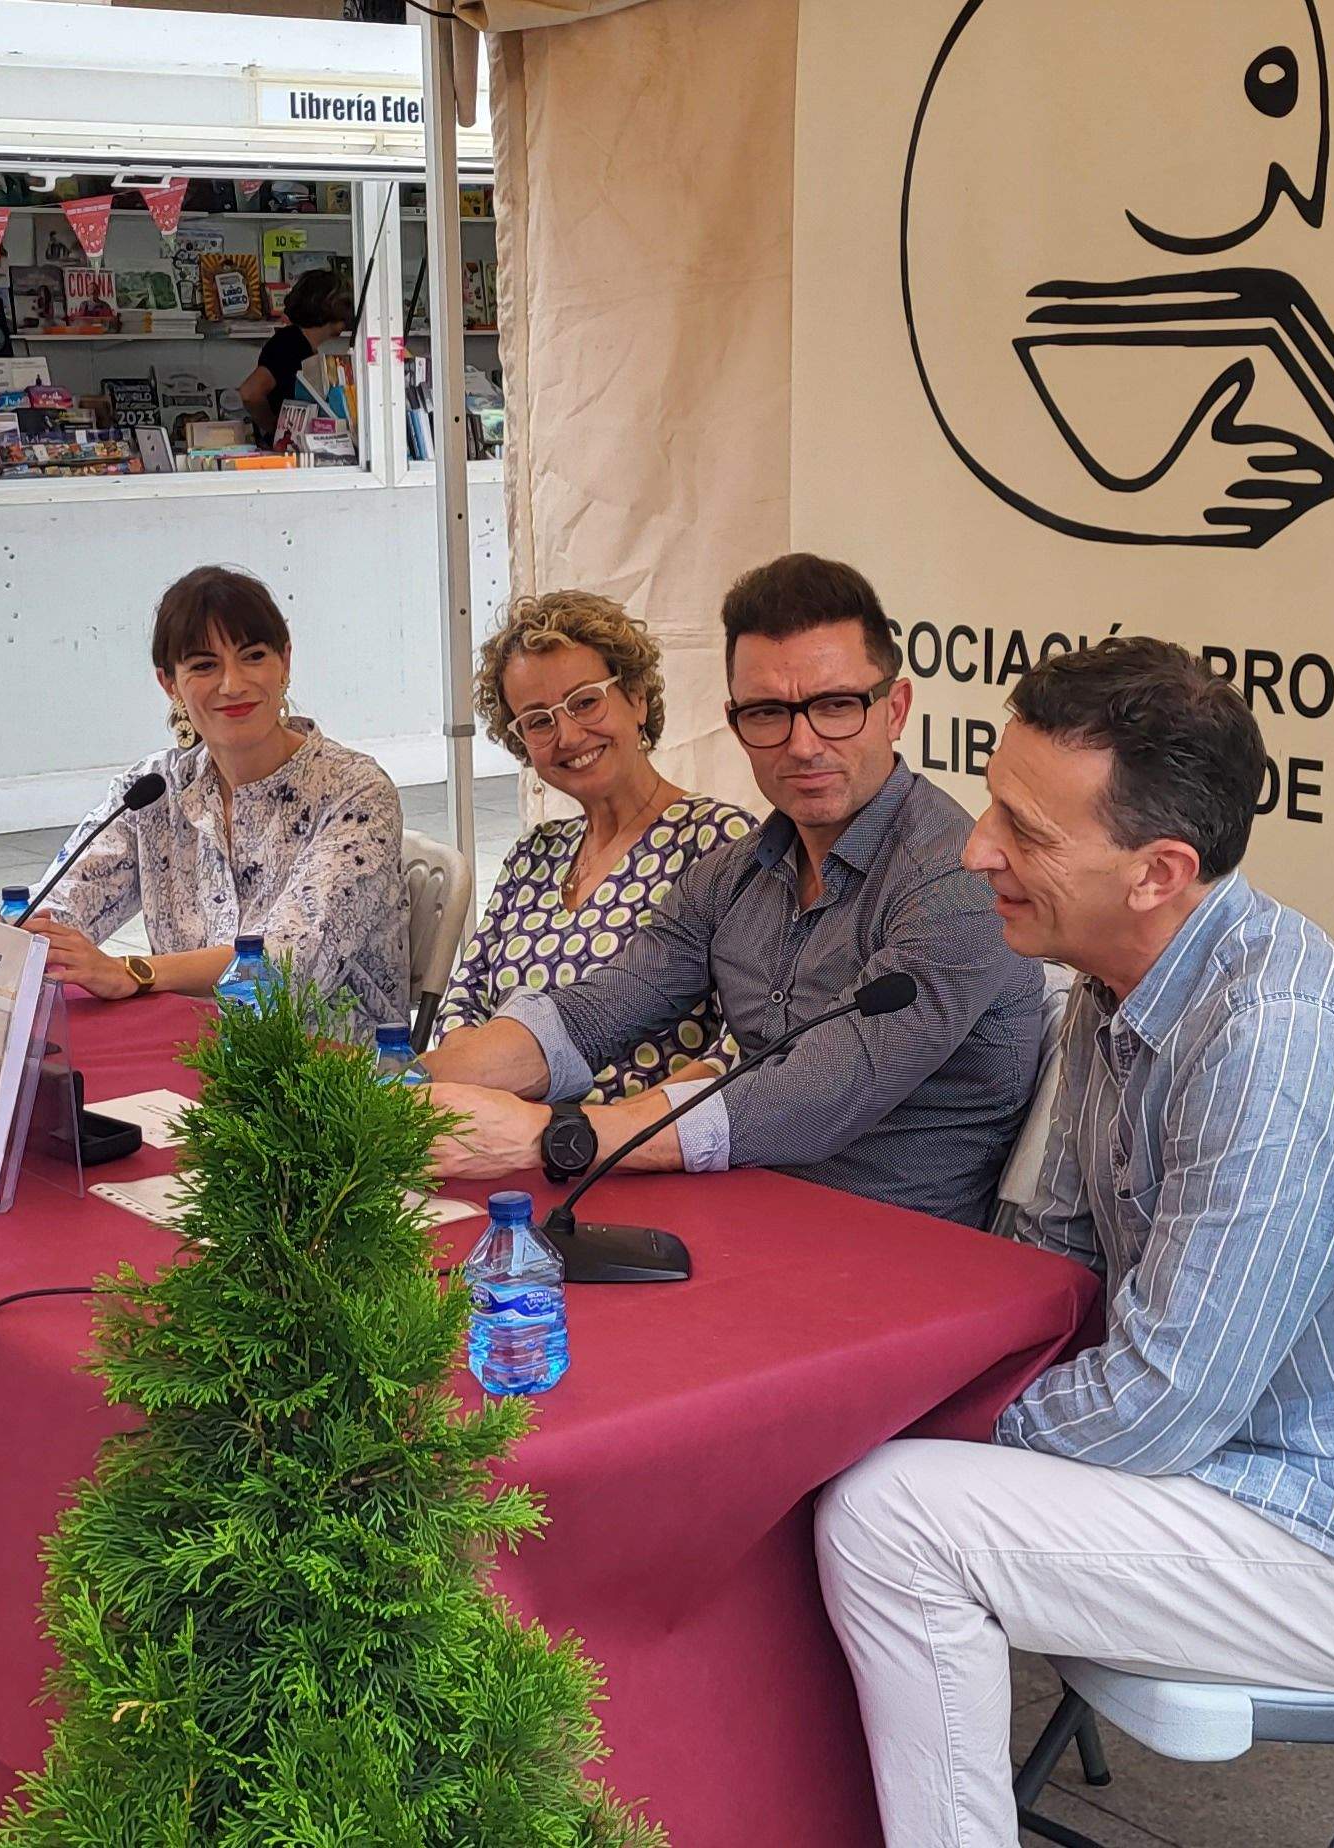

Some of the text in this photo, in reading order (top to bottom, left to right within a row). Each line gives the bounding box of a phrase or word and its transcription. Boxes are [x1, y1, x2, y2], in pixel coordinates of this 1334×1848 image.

[290, 92, 425, 123] Librería Edel
[116, 410, 155, 425] 2023
